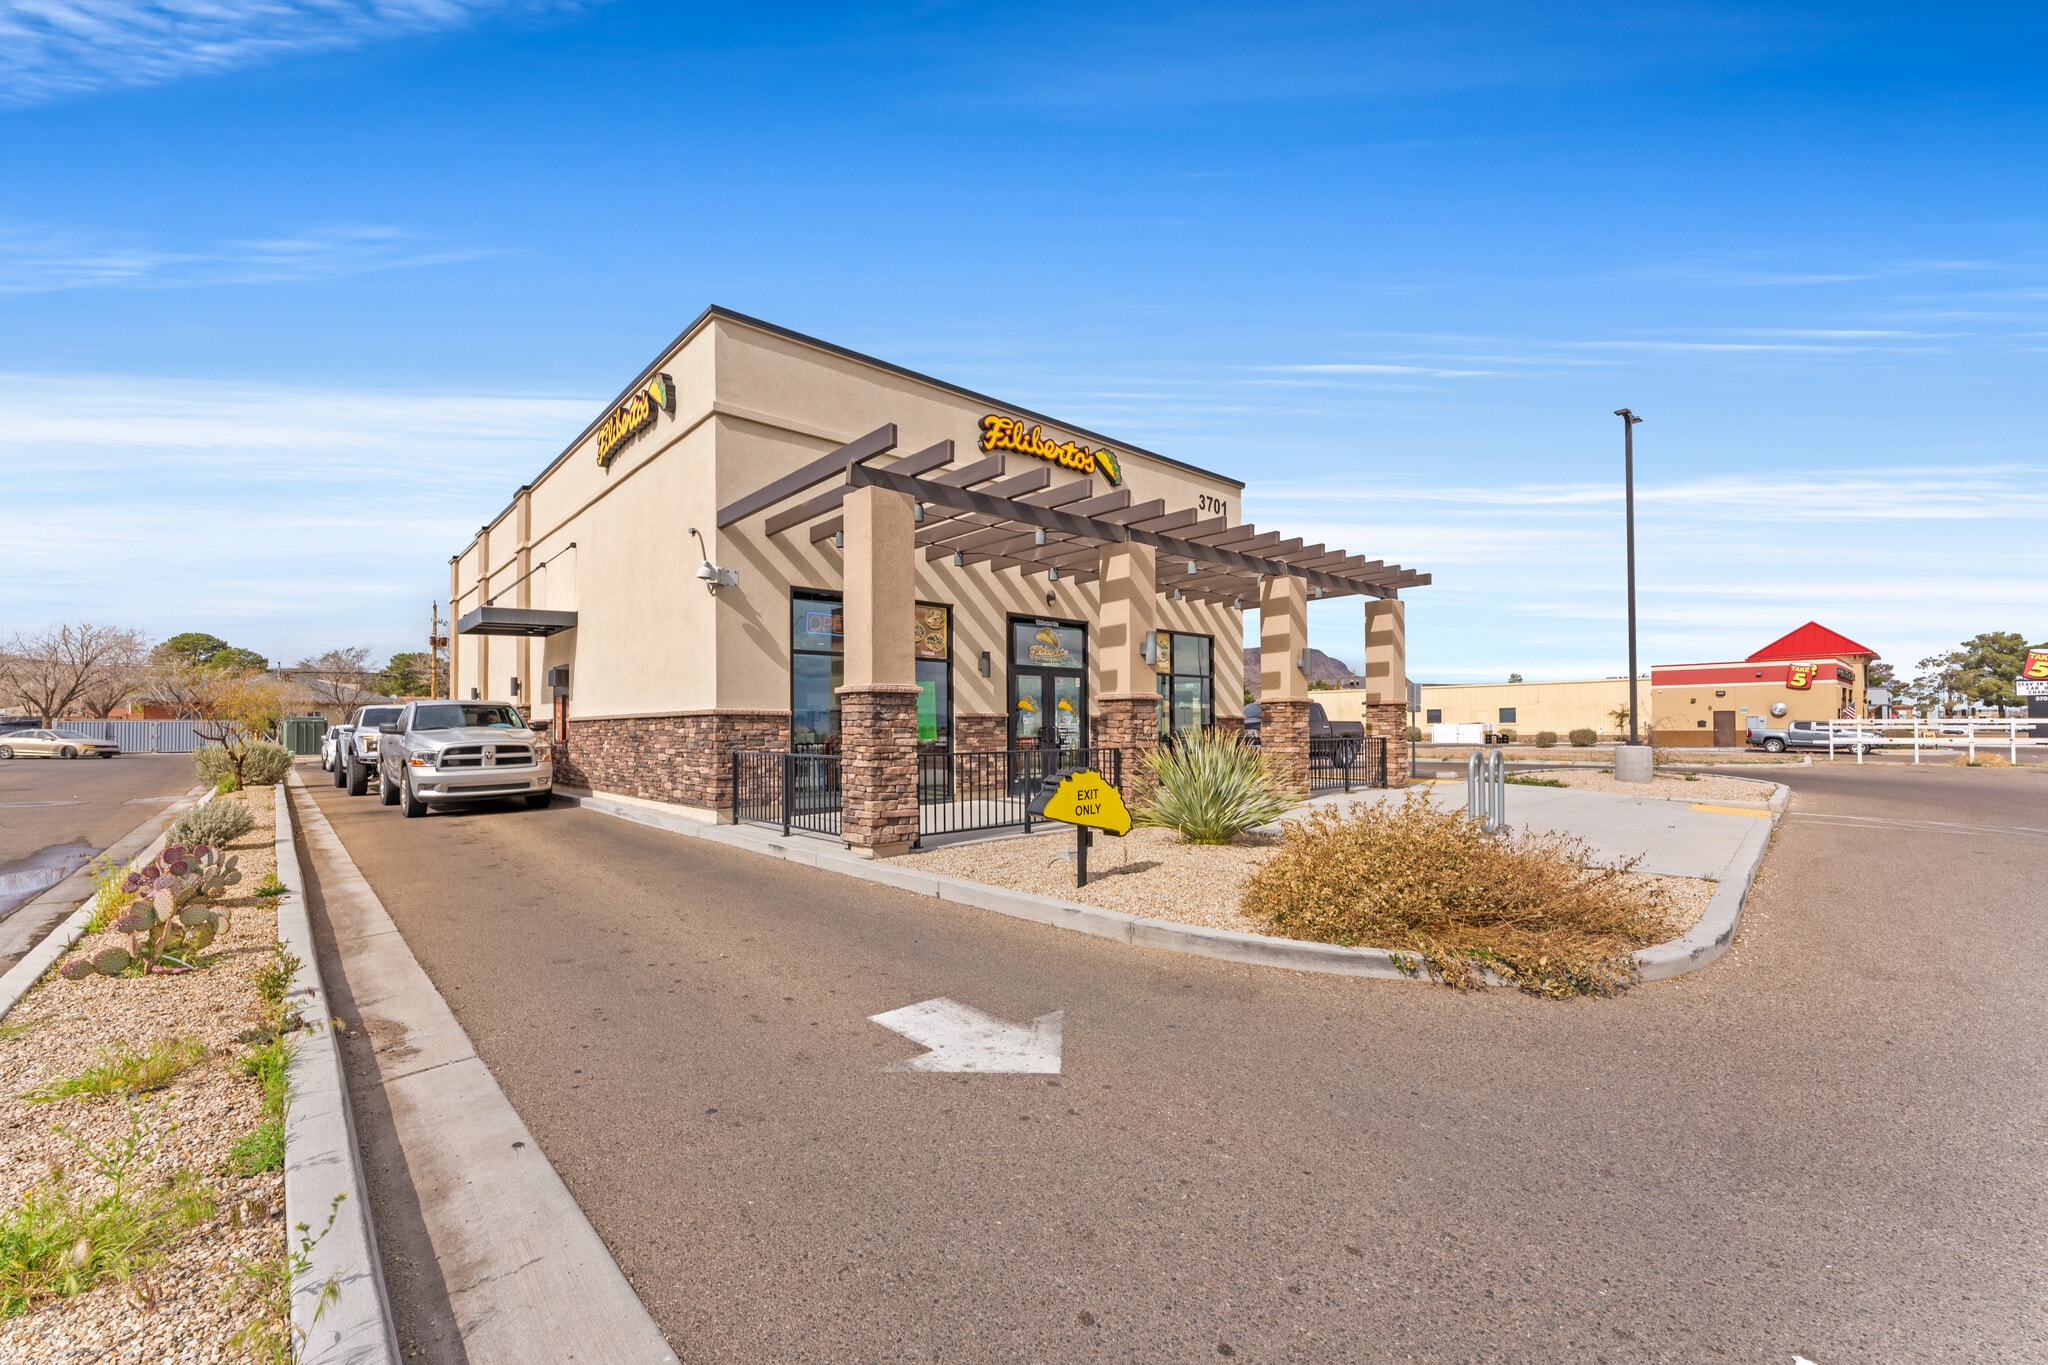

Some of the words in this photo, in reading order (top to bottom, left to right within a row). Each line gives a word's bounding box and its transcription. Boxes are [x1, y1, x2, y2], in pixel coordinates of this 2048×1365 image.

[982, 414, 1096, 474] Filiberto's
[1198, 494, 1227, 517] 3701
[808, 614, 843, 635] OPE
[2030, 653, 2048, 661] TAK
[2027, 661, 2048, 678] 5
[1789, 672, 1807, 687] 5
[1077, 789, 1099, 801] EXIT
[1075, 804, 1101, 816] ONLY
